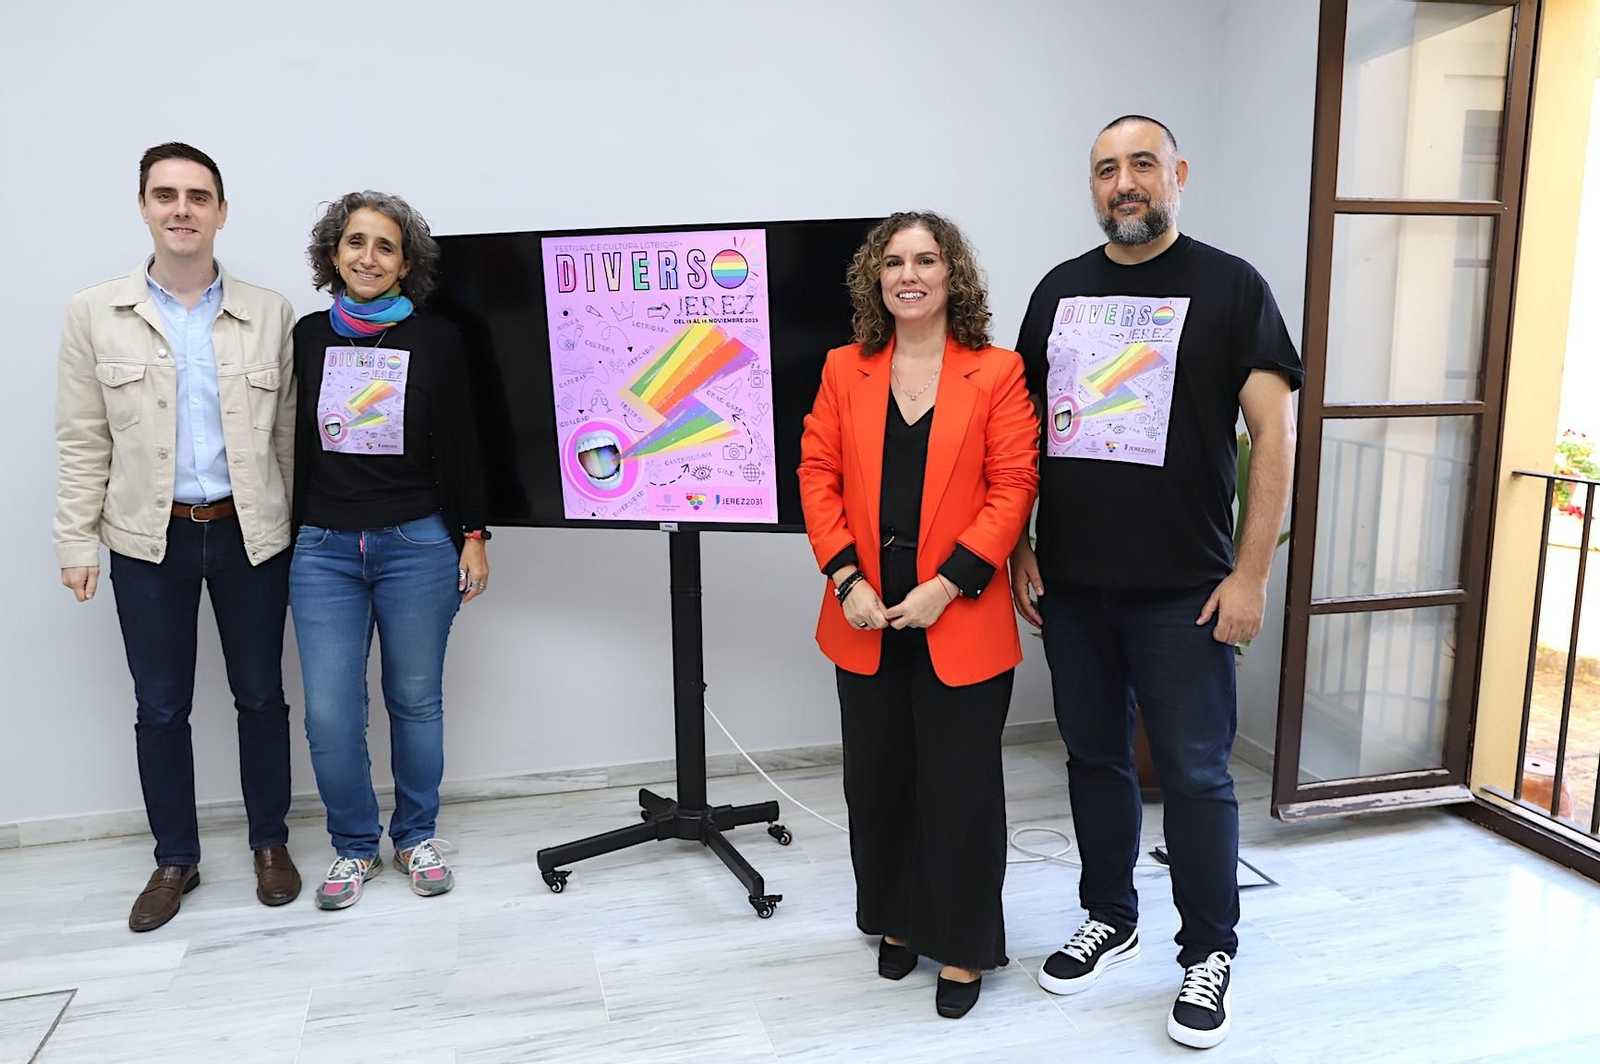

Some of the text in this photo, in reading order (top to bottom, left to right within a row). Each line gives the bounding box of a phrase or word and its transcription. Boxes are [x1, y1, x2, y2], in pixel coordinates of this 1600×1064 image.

[555, 244, 590, 252] FESTIVAL
[591, 243, 601, 251] DE
[603, 242, 639, 251] CULTURA
[555, 249, 749, 294] DIVERSO
[676, 294, 754, 317] JEREZ
[1127, 327, 1174, 340] JEREZ
[717, 467, 735, 477] CINE
[722, 497, 763, 506] JEREZ2031
